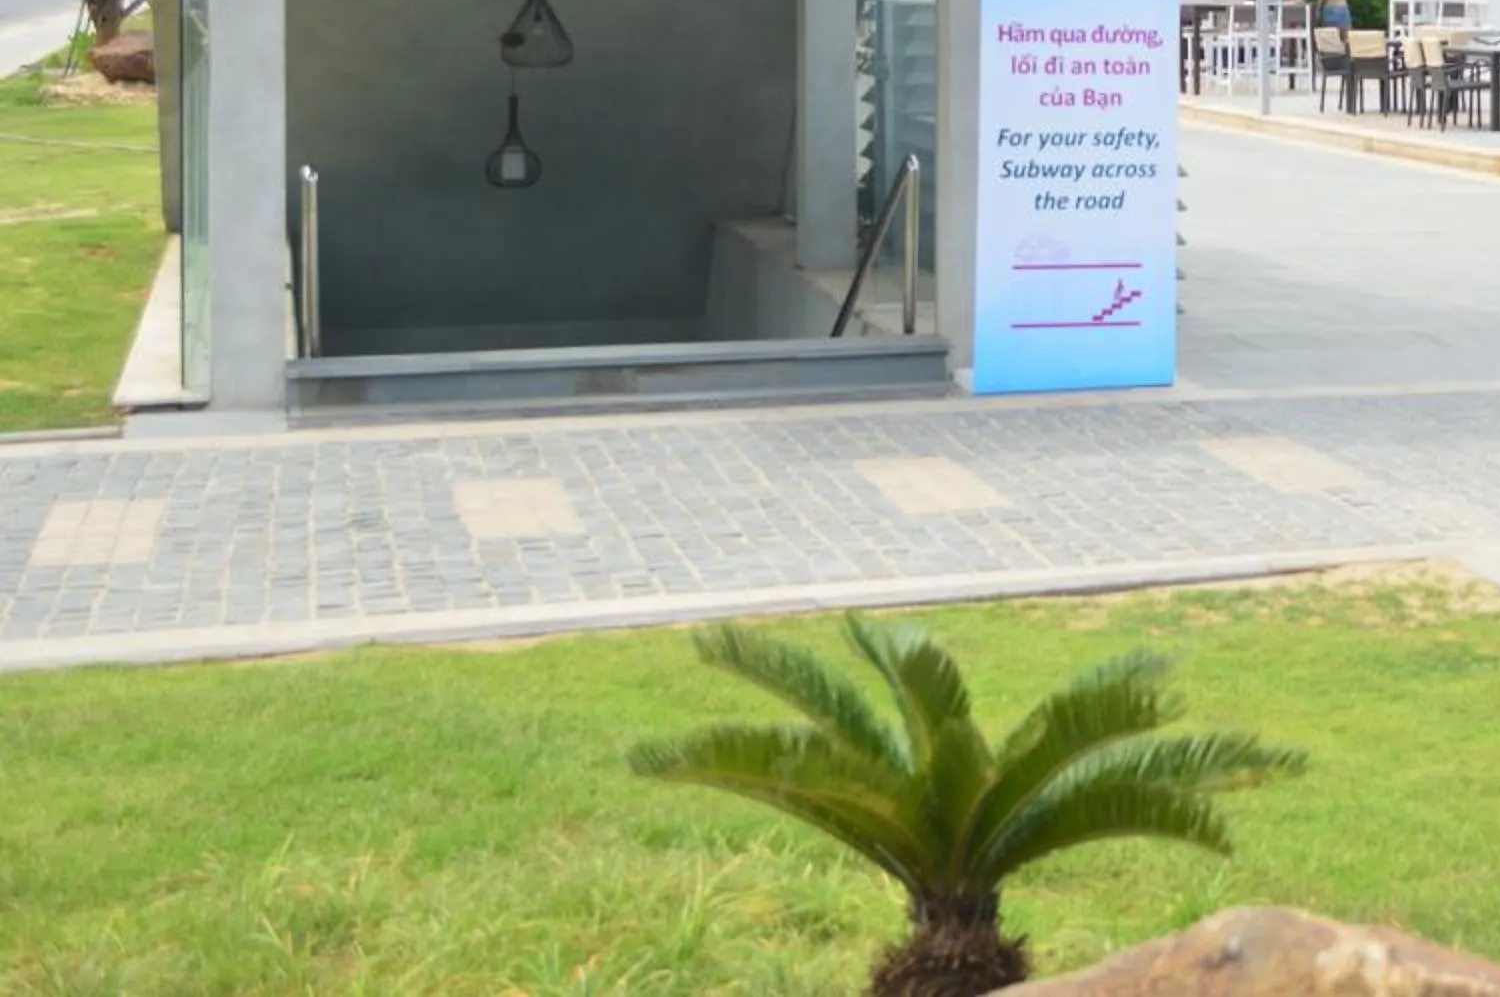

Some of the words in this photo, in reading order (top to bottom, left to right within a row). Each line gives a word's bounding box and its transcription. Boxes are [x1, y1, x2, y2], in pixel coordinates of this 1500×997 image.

[1051, 28, 1086, 48] qua
[1091, 24, 1164, 49] đường,
[1011, 53, 1037, 75] lối
[1044, 56, 1064, 75] đi
[1071, 60, 1096, 75] an
[1104, 55, 1151, 75] toàn
[1039, 85, 1075, 107] của
[1083, 88, 1122, 111] Bạn
[997, 128, 1033, 147] For
[1038, 132, 1087, 150] your
[1091, 127, 1160, 150] safety,
[1000, 159, 1085, 182] Subway
[1091, 163, 1158, 179] across
[1034, 190, 1069, 210] the
[1075, 190, 1125, 210] road
